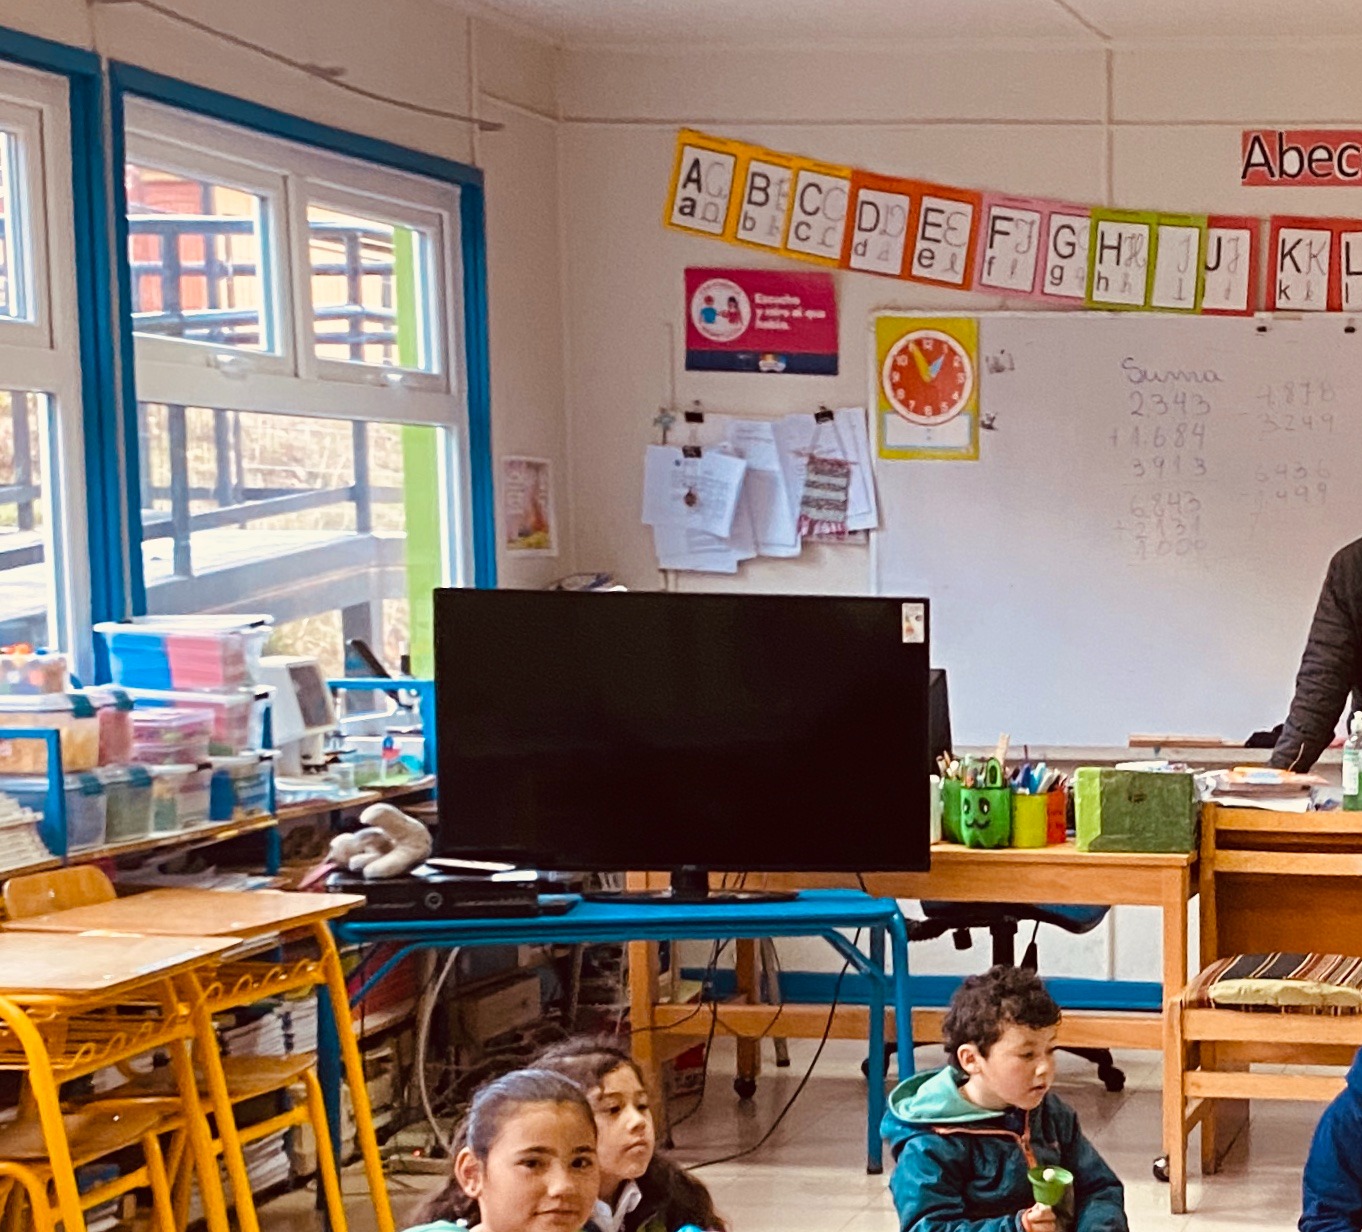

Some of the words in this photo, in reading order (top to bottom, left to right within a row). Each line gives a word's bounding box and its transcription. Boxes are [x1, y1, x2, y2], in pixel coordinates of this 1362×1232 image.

[682, 157, 702, 193] A
[747, 171, 771, 207] B
[678, 196, 697, 217] a
[799, 182, 823, 216] C
[742, 211, 756, 232] b
[857, 200, 881, 232] D
[921, 207, 944, 243] E
[794, 221, 811, 242] c
[989, 215, 1014, 249] F
[1053, 223, 1076, 259] G
[854, 238, 868, 258] d
[917, 247, 935, 268] e
[1098, 231, 1122, 266] H
[1204, 236, 1222, 271] J
[1279, 237, 1303, 273] K
[986, 256, 997, 277] f
[1050, 264, 1064, 286] g
[1096, 270, 1109, 292] h
[1278, 279, 1291, 301] k
[1120, 356, 1225, 385] Suma
